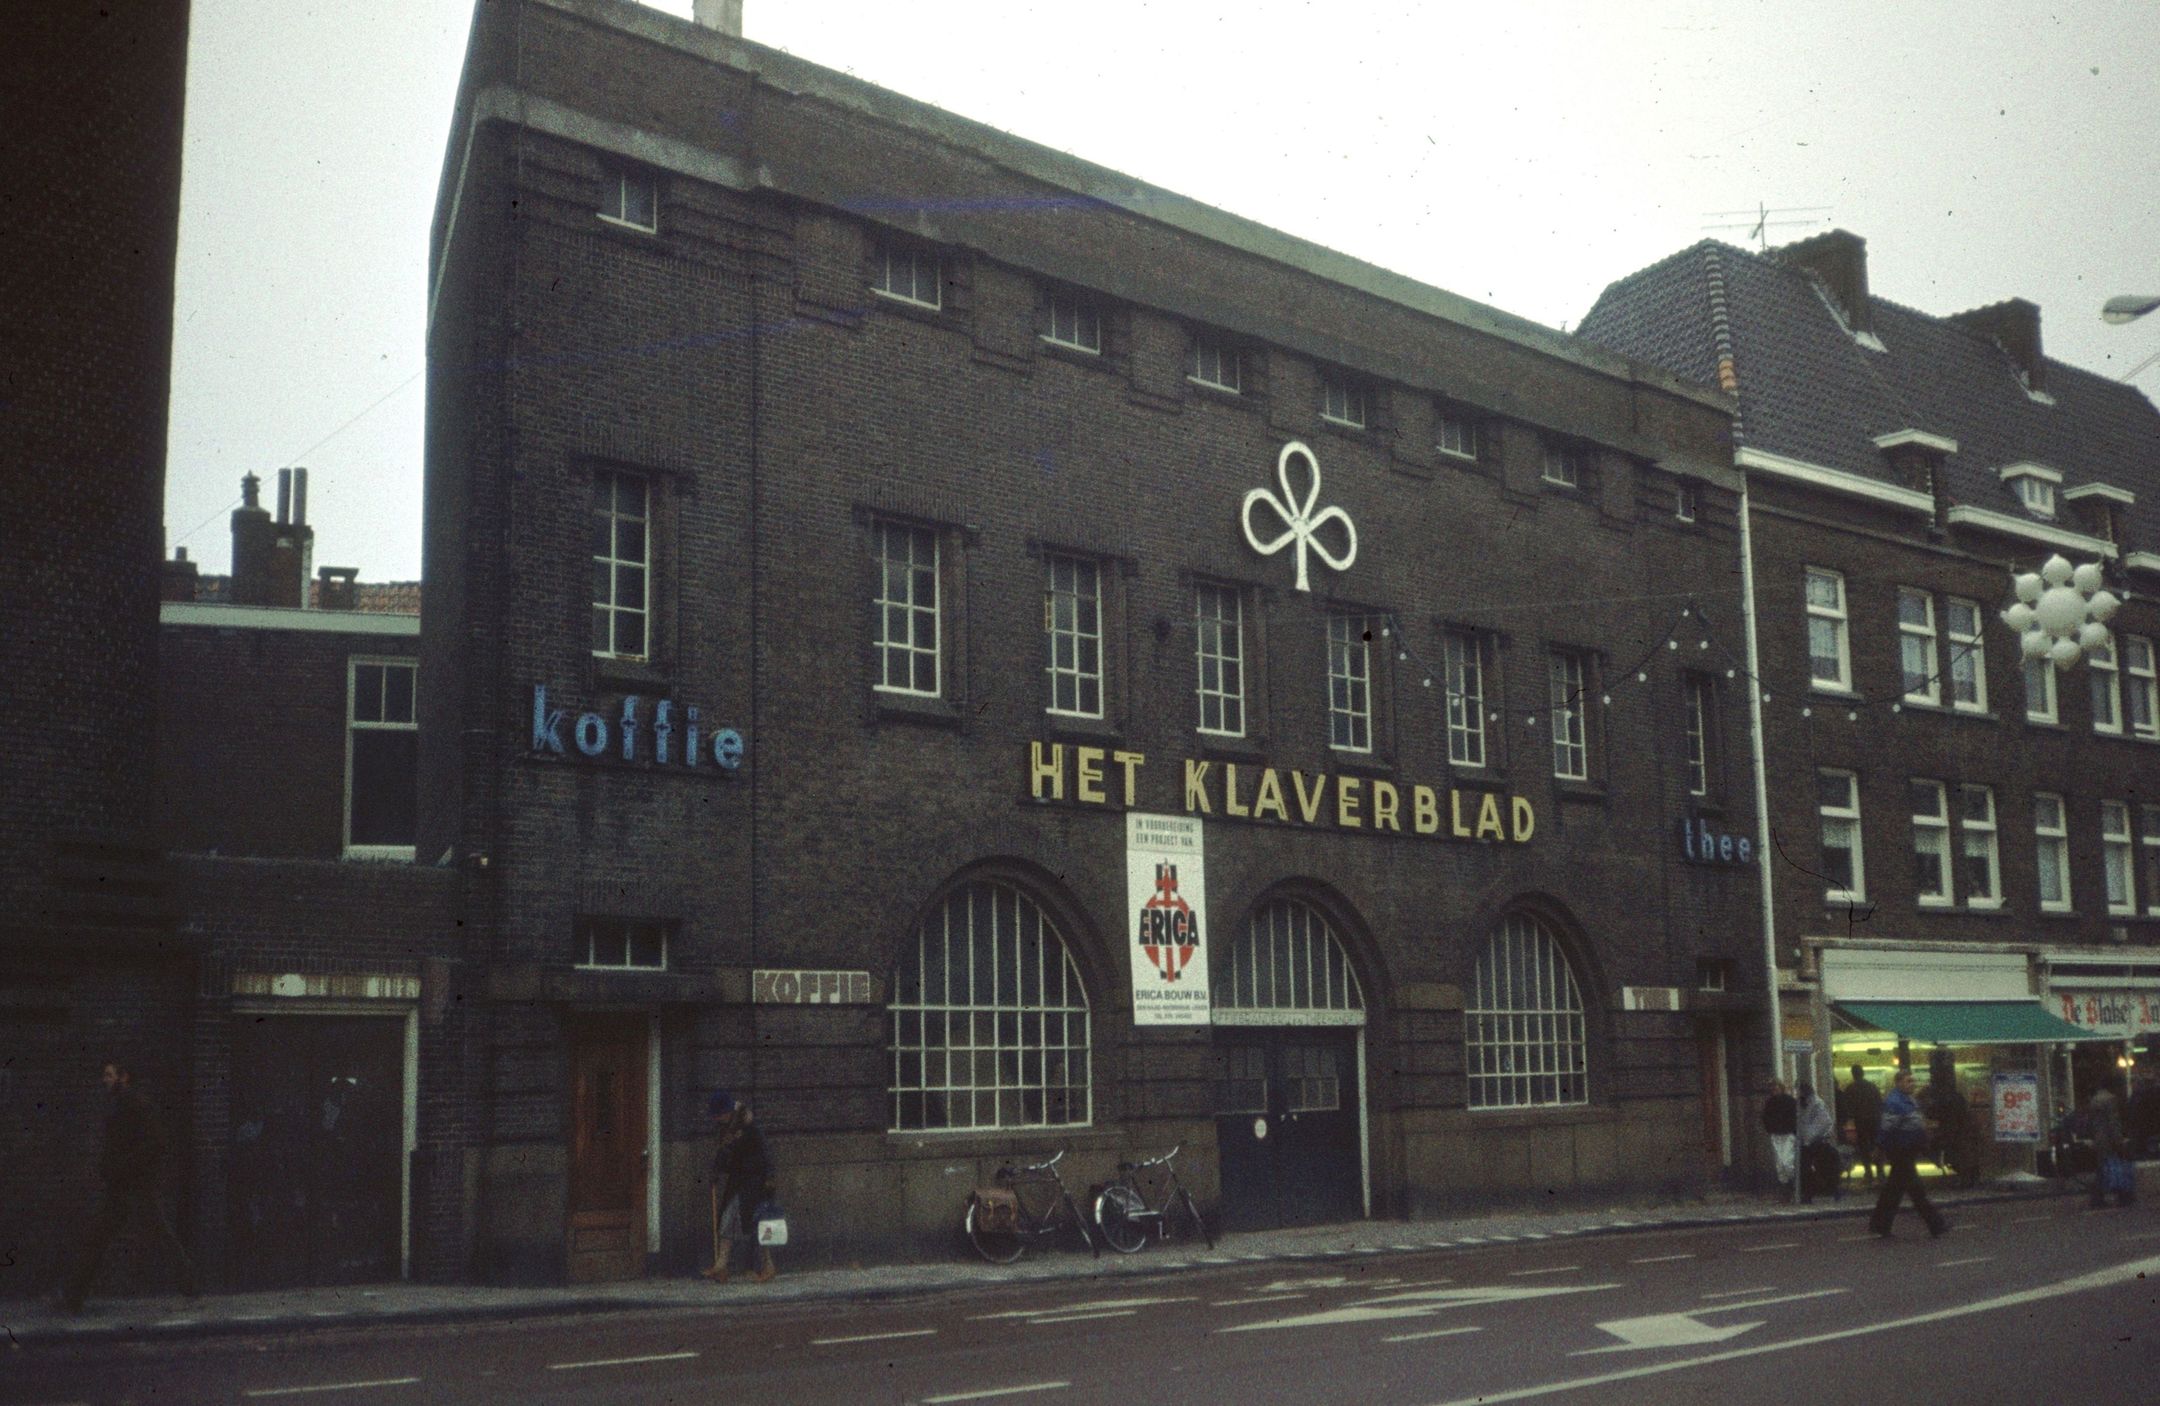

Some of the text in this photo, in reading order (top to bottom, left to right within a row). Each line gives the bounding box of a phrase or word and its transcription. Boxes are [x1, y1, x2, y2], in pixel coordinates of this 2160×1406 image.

[532, 684, 744, 770] koffie
[1031, 740, 1536, 843] HET KLAVERBLAD
[1135, 833, 1193, 846] EEN PROJECT VAN
[1684, 818, 1751, 863] thee
[1139, 908, 1199, 947] ERICA
[754, 971, 870, 1003] KOFFIE
[1136, 990, 1163, 1001] ERICA
[1164, 991, 1192, 1001] BOUW
